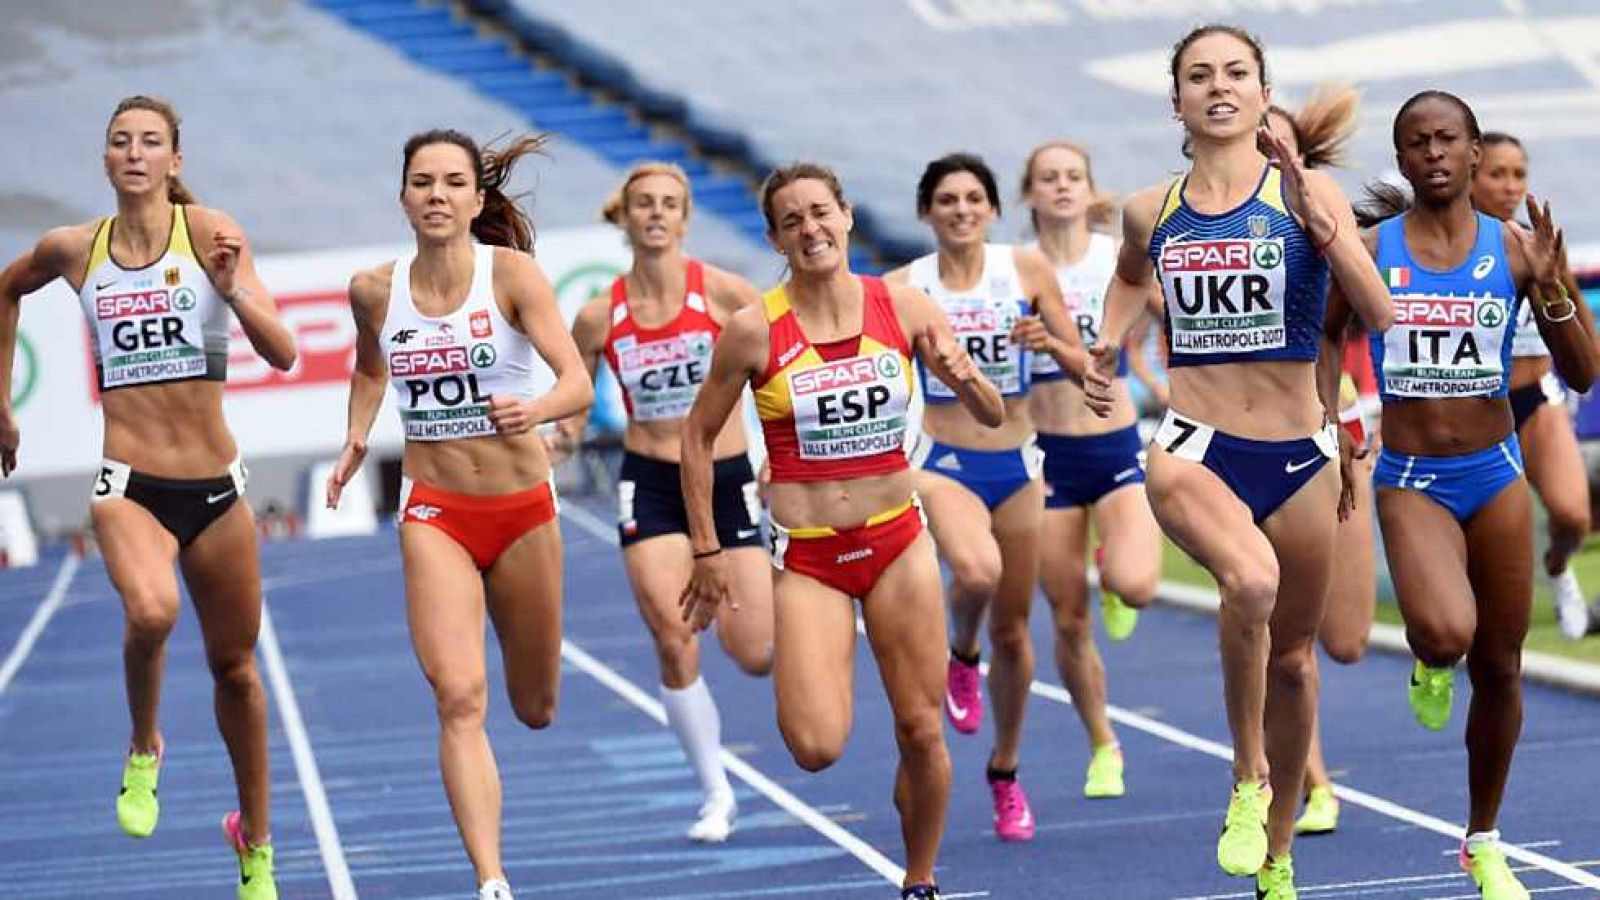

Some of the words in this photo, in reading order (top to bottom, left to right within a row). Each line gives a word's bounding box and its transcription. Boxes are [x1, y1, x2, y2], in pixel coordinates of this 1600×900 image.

[1164, 245, 1249, 268] SPAR
[99, 292, 168, 316] SPAR
[1173, 275, 1273, 315] UKR
[112, 317, 187, 351] GER
[391, 329, 418, 343] 4F
[1194, 331, 1259, 348] METROPOLE
[1262, 329, 1283, 344] 2017
[1409, 330, 1482, 364] ITA
[955, 334, 1008, 362] RE
[126, 361, 184, 378] METROPOLE
[391, 350, 467, 373] SPAR
[1442, 369, 1476, 379] CLEAN
[640, 361, 703, 390] CZE
[794, 361, 876, 393] SPAR
[1411, 381, 1477, 394] METROPOLE
[405, 374, 492, 407] POL
[817, 385, 890, 426] ESP
[425, 419, 485, 435] METROPOLE
[1165, 417, 1198, 453] 7
[829, 433, 890, 453] METROPOLE
[96, 467, 113, 496] 5
